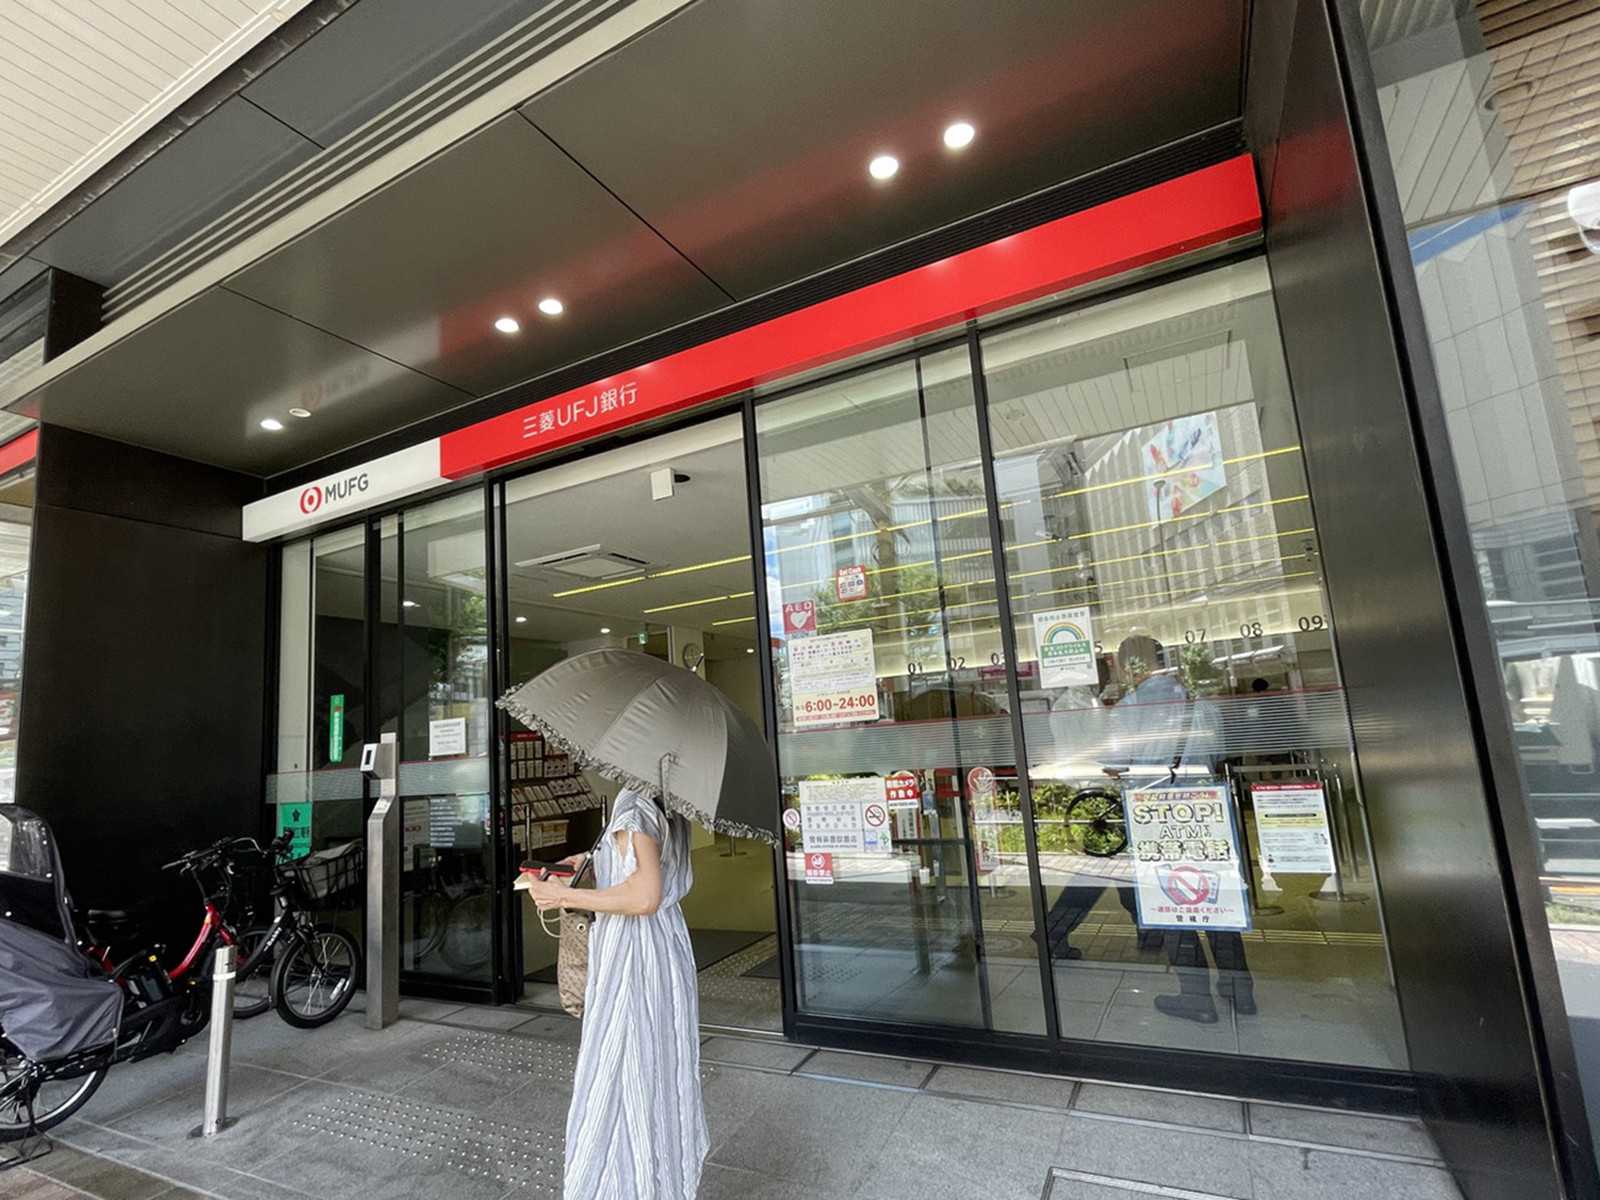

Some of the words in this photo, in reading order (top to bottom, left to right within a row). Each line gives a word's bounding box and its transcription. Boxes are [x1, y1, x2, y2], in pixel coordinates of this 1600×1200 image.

[522, 382, 637, 439] 三菱UFJ銀行
[325, 473, 369, 503] MUFG
[785, 601, 812, 613] AED
[1240, 622, 1263, 638] 08
[1298, 615, 1323, 631] 09
[1185, 629, 1206, 644] 07
[907, 662, 923, 676] 01
[950, 656, 966, 671] 02
[1133, 802, 1224, 824] STOP!
[1138, 840, 1231, 861] 携帯電話
